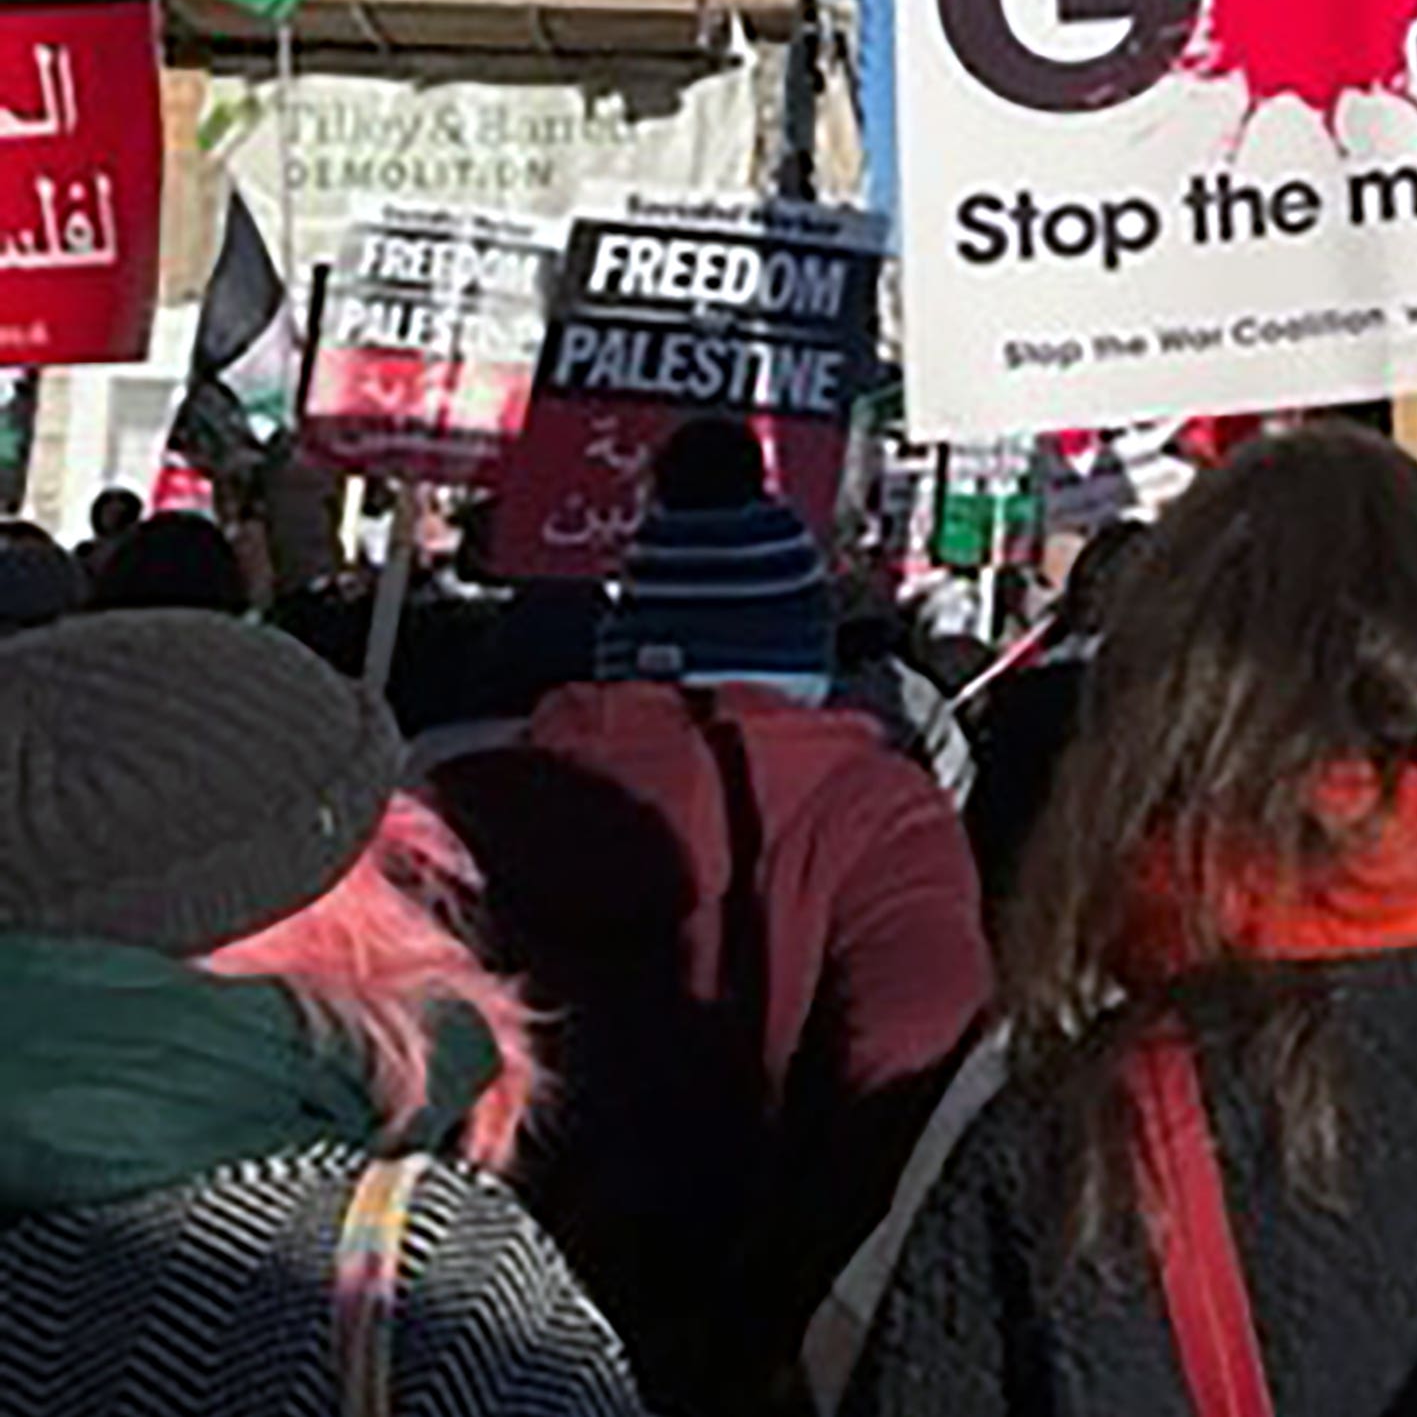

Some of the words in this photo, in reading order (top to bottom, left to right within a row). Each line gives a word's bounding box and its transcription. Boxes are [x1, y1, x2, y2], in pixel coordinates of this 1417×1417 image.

[955, 190, 1160, 271] Stop
[1185, 169, 1322, 243] the
[587, 233, 849, 319] FREEDOM
[553, 323, 844, 415] PALESTINE
[1002, 339, 1084, 370] Stop
[1091, 333, 1149, 360] the
[1158, 325, 1222, 354] War
[1231, 306, 1385, 347] Coalition
